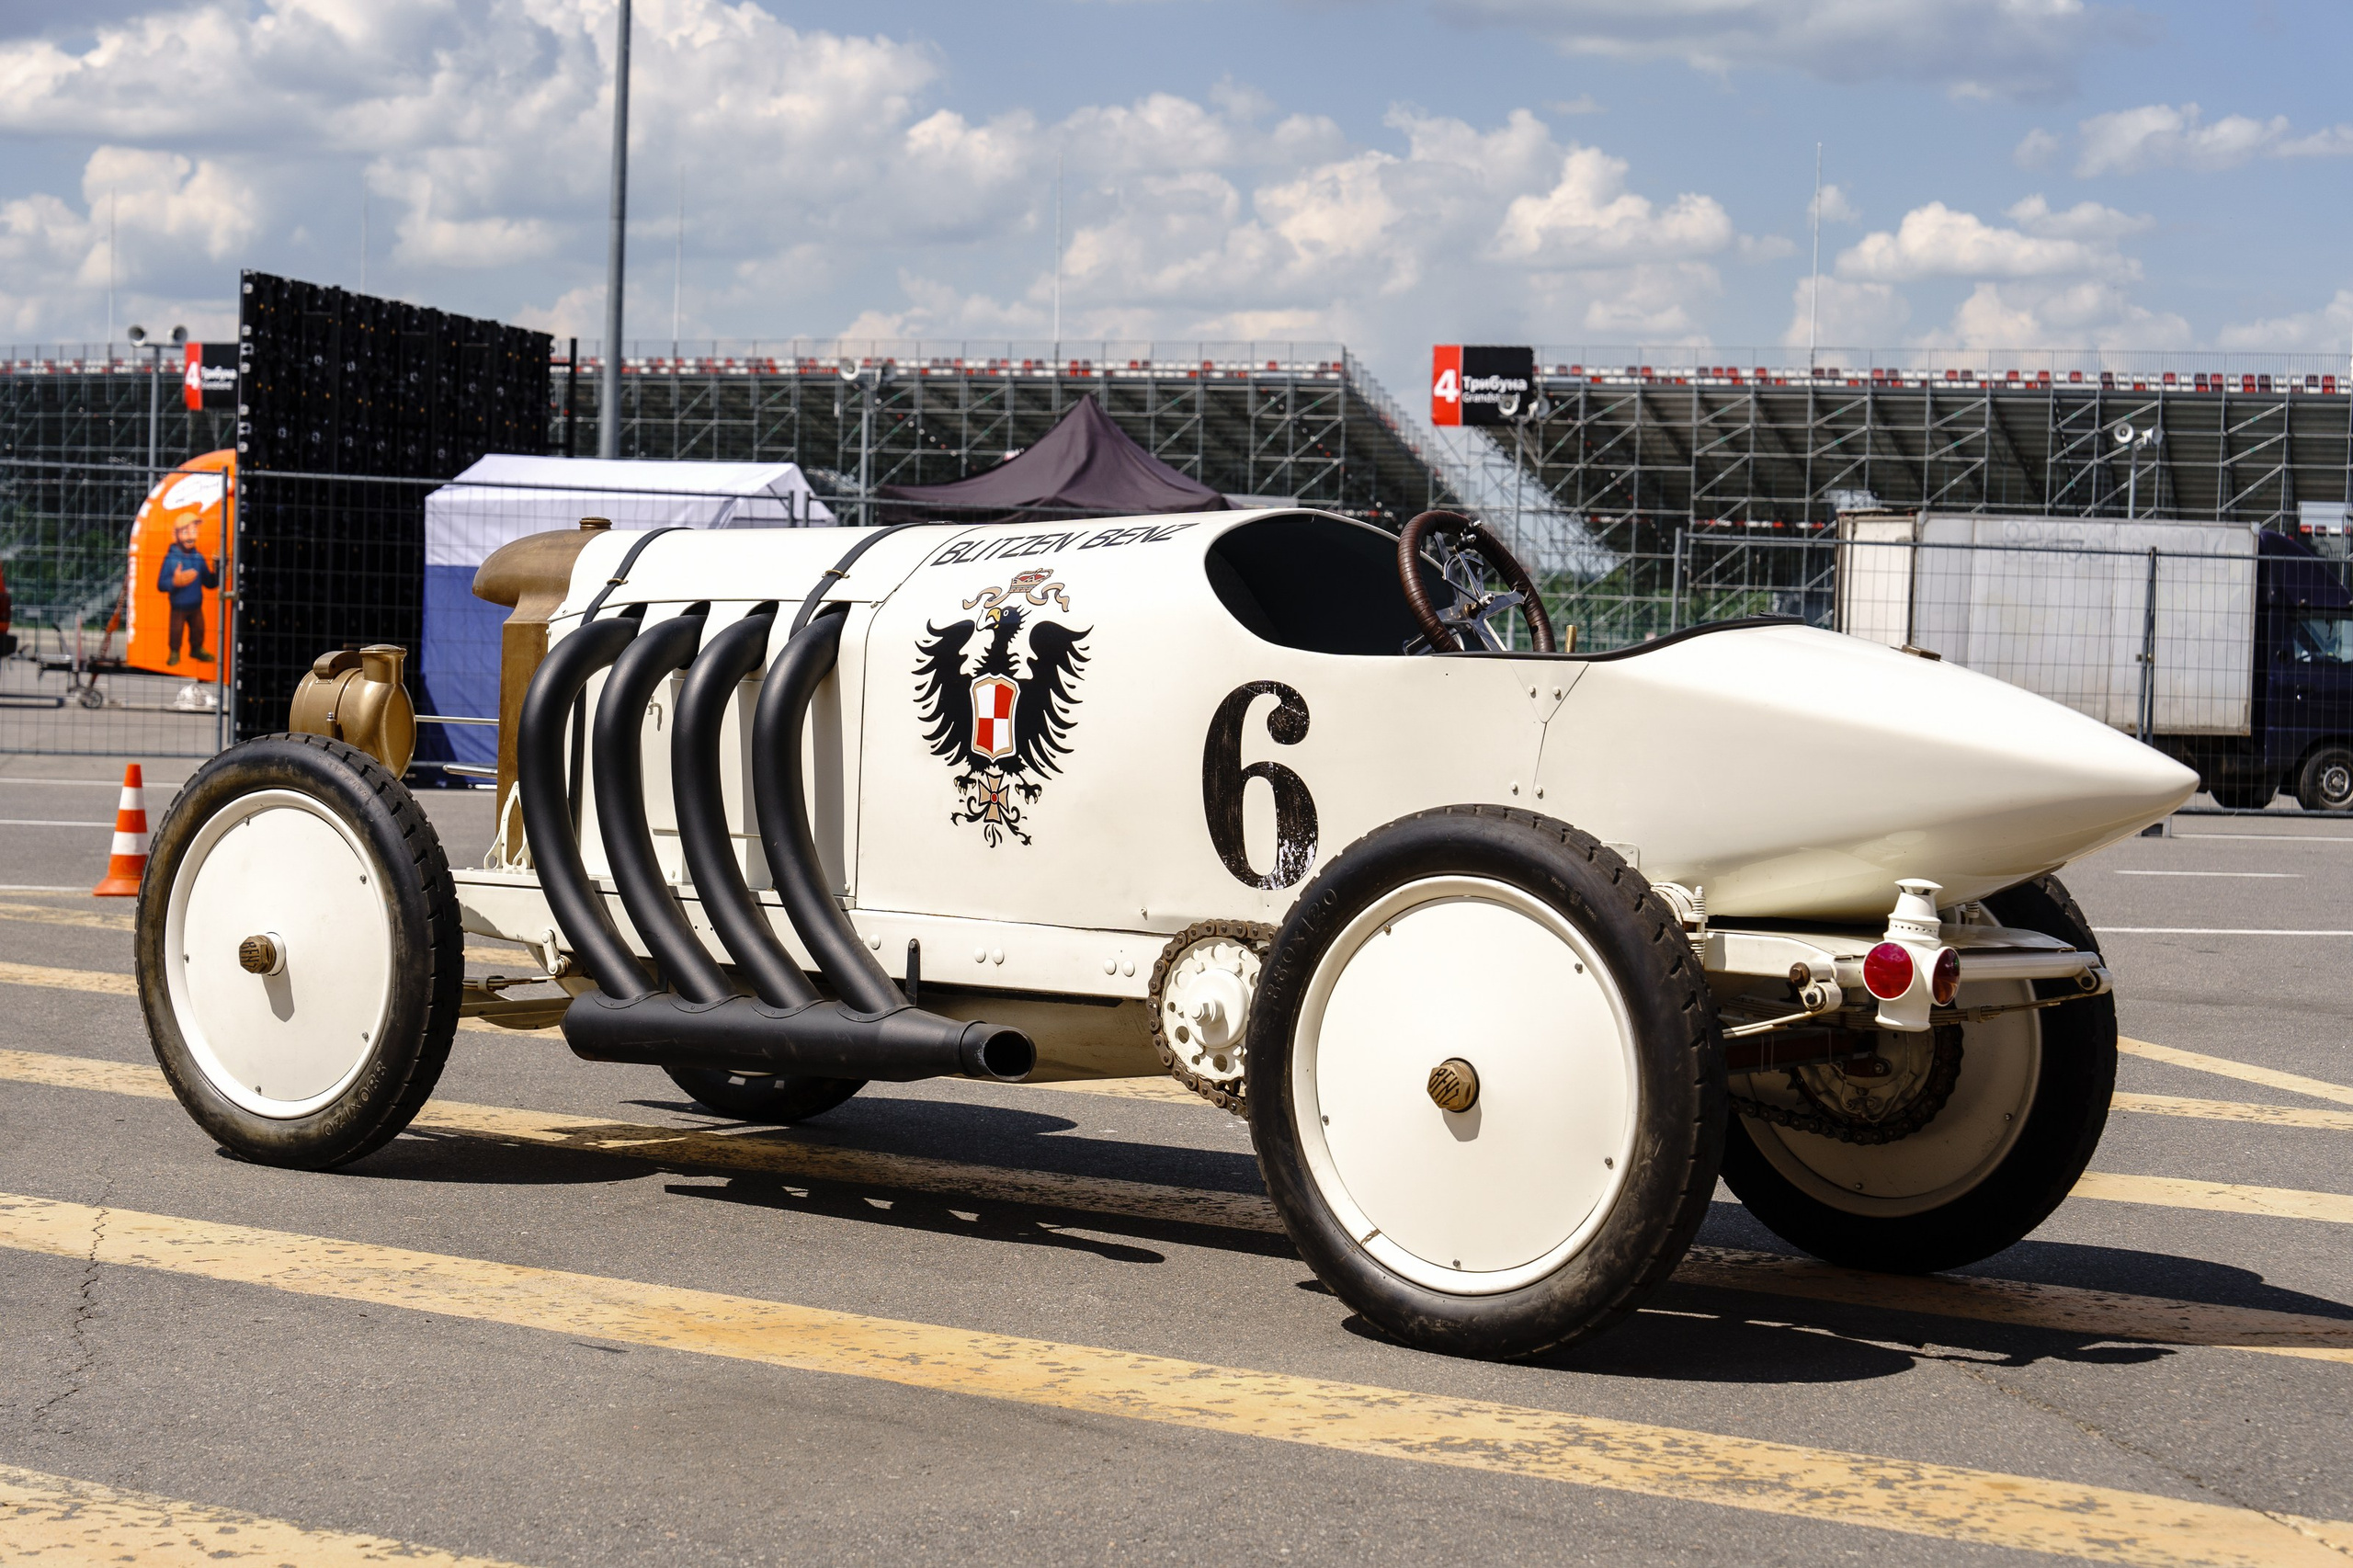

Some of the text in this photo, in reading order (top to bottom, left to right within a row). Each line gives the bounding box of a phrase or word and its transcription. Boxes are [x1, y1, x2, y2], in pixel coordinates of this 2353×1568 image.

[185, 361, 200, 390] 4
[1434, 369, 1460, 403] 4
[1462, 375, 1528, 393] Трибуна
[930, 523, 1200, 567] BLITZEN BENZ
[1202, 680, 1319, 891] 6
[1428, 1068, 1461, 1106] BENZ
